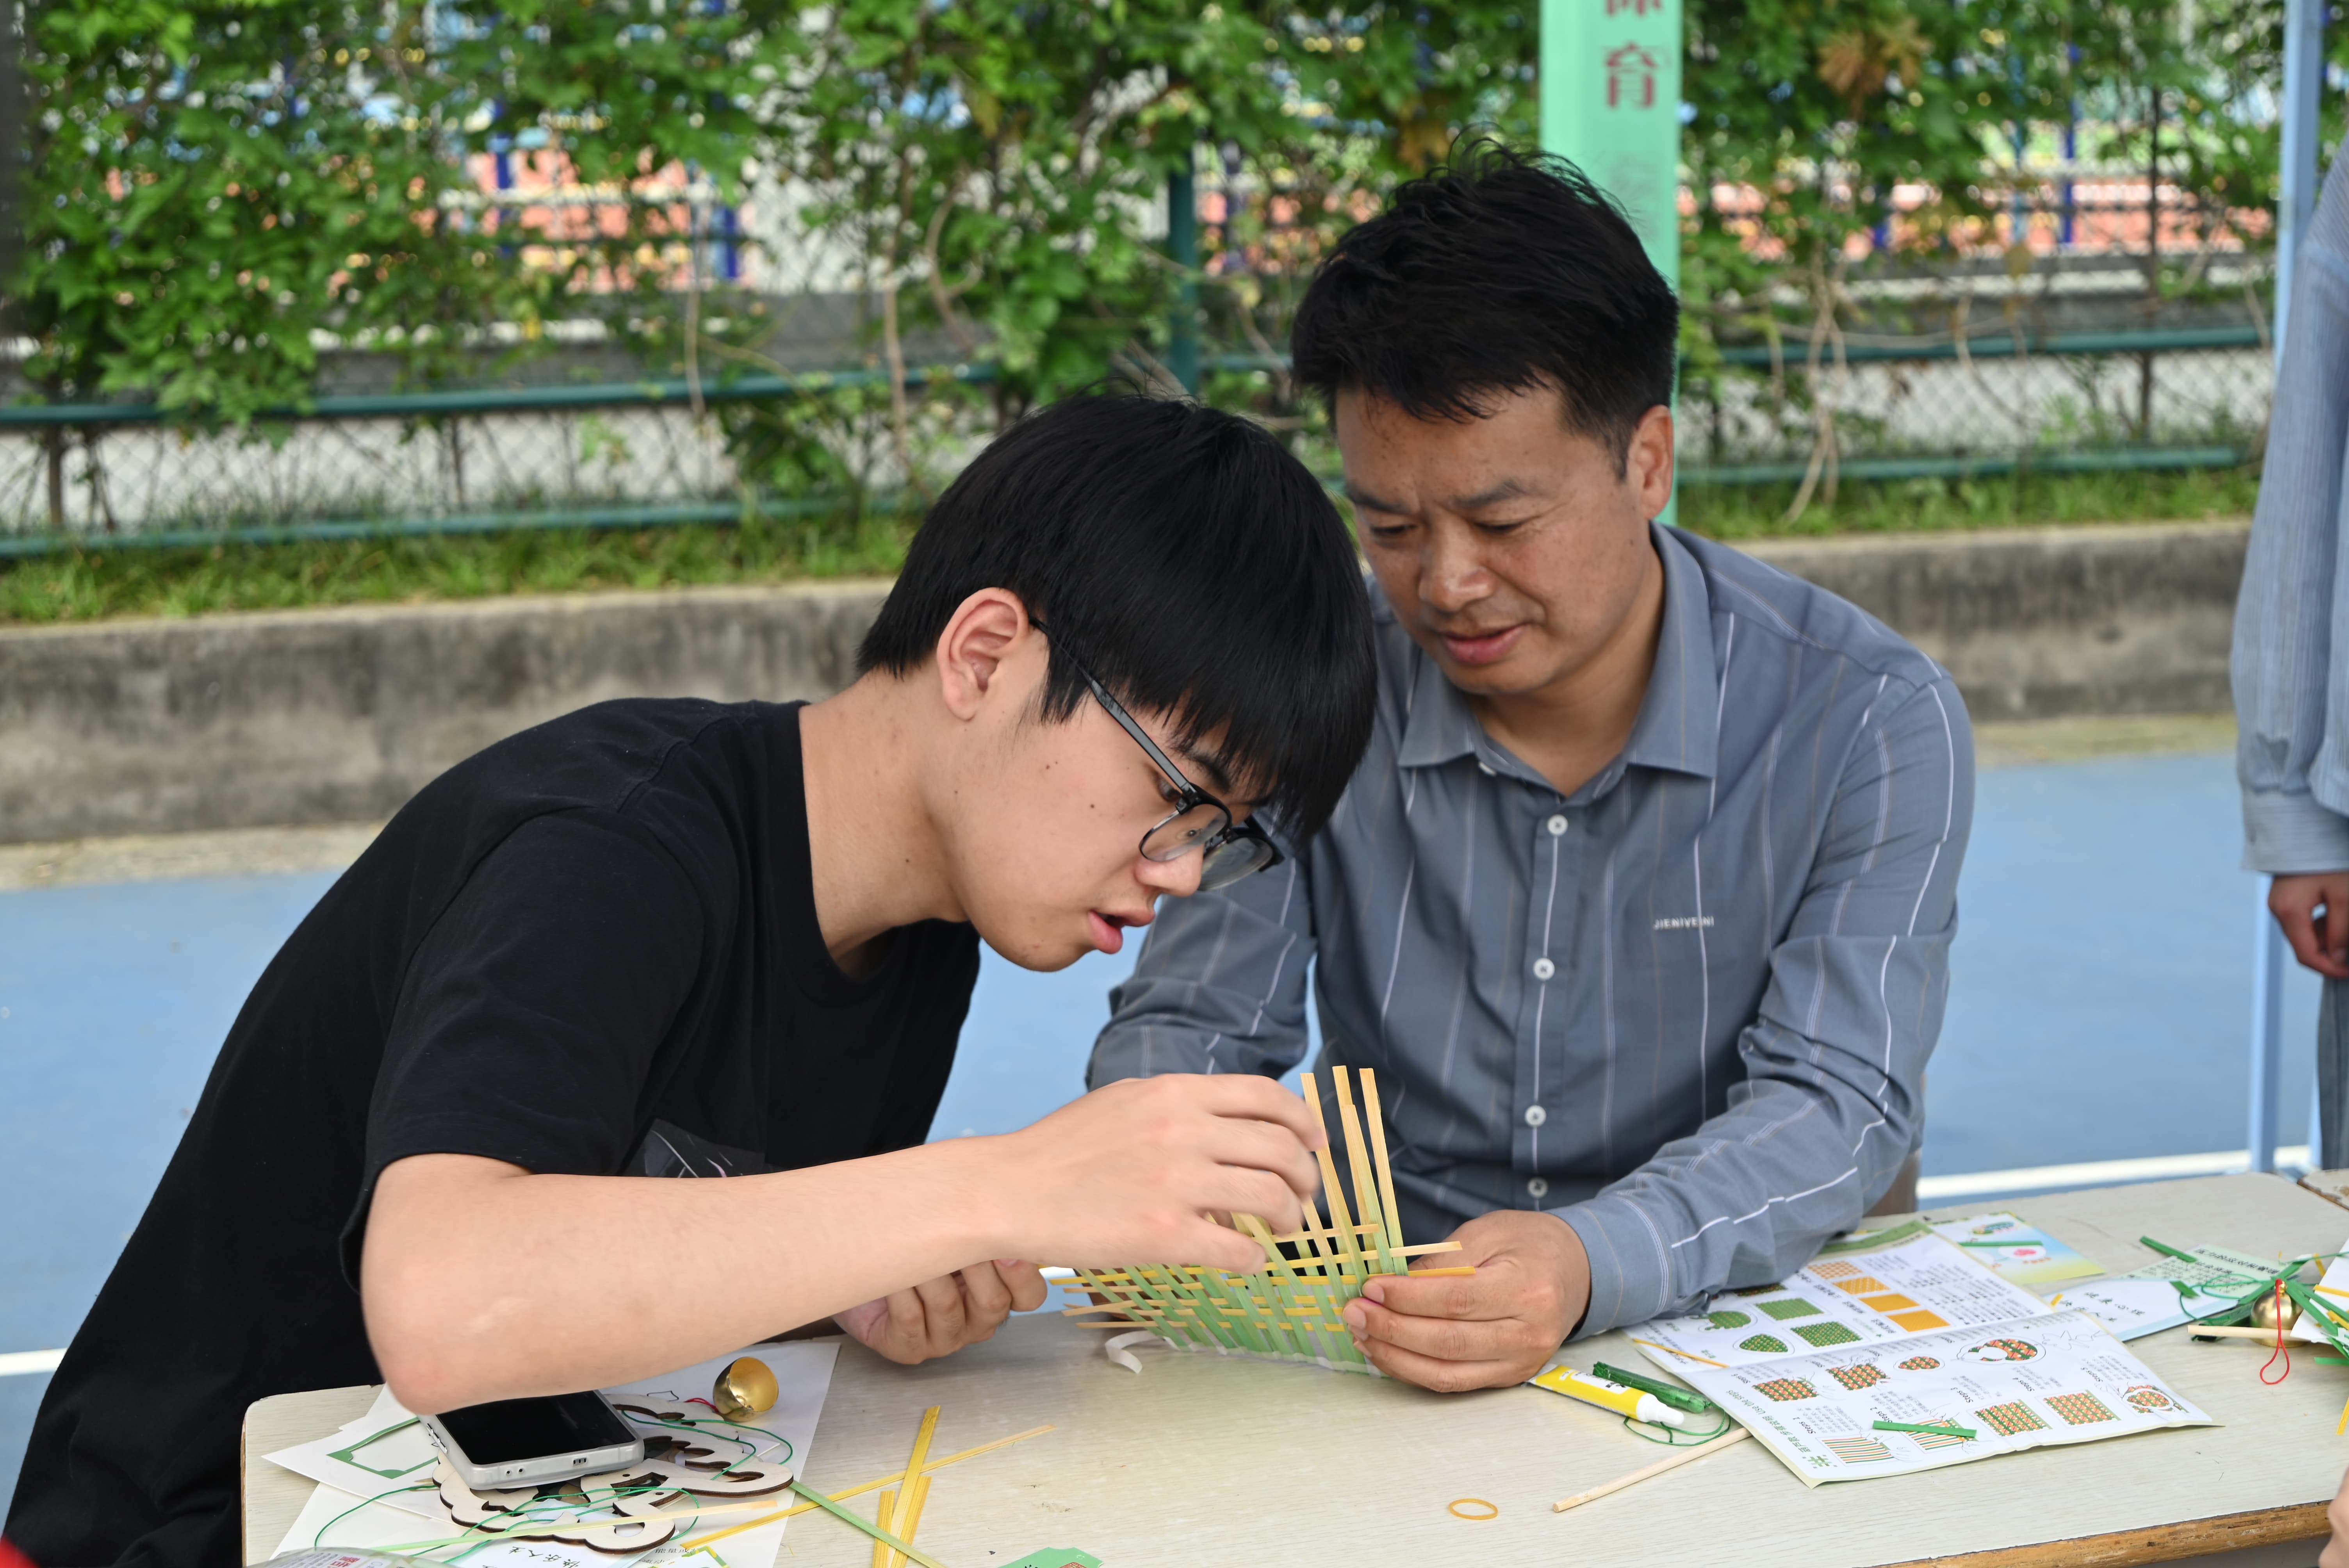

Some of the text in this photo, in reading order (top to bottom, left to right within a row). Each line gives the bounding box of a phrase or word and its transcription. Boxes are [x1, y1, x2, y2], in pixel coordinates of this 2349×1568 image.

[1956, 1390, 1973, 1403] Steps
[1752, 1406, 1766, 1414] Use
[1798, 1421, 1816, 1434] Steps
[509, 1546, 580, 1568] 快乐人生
